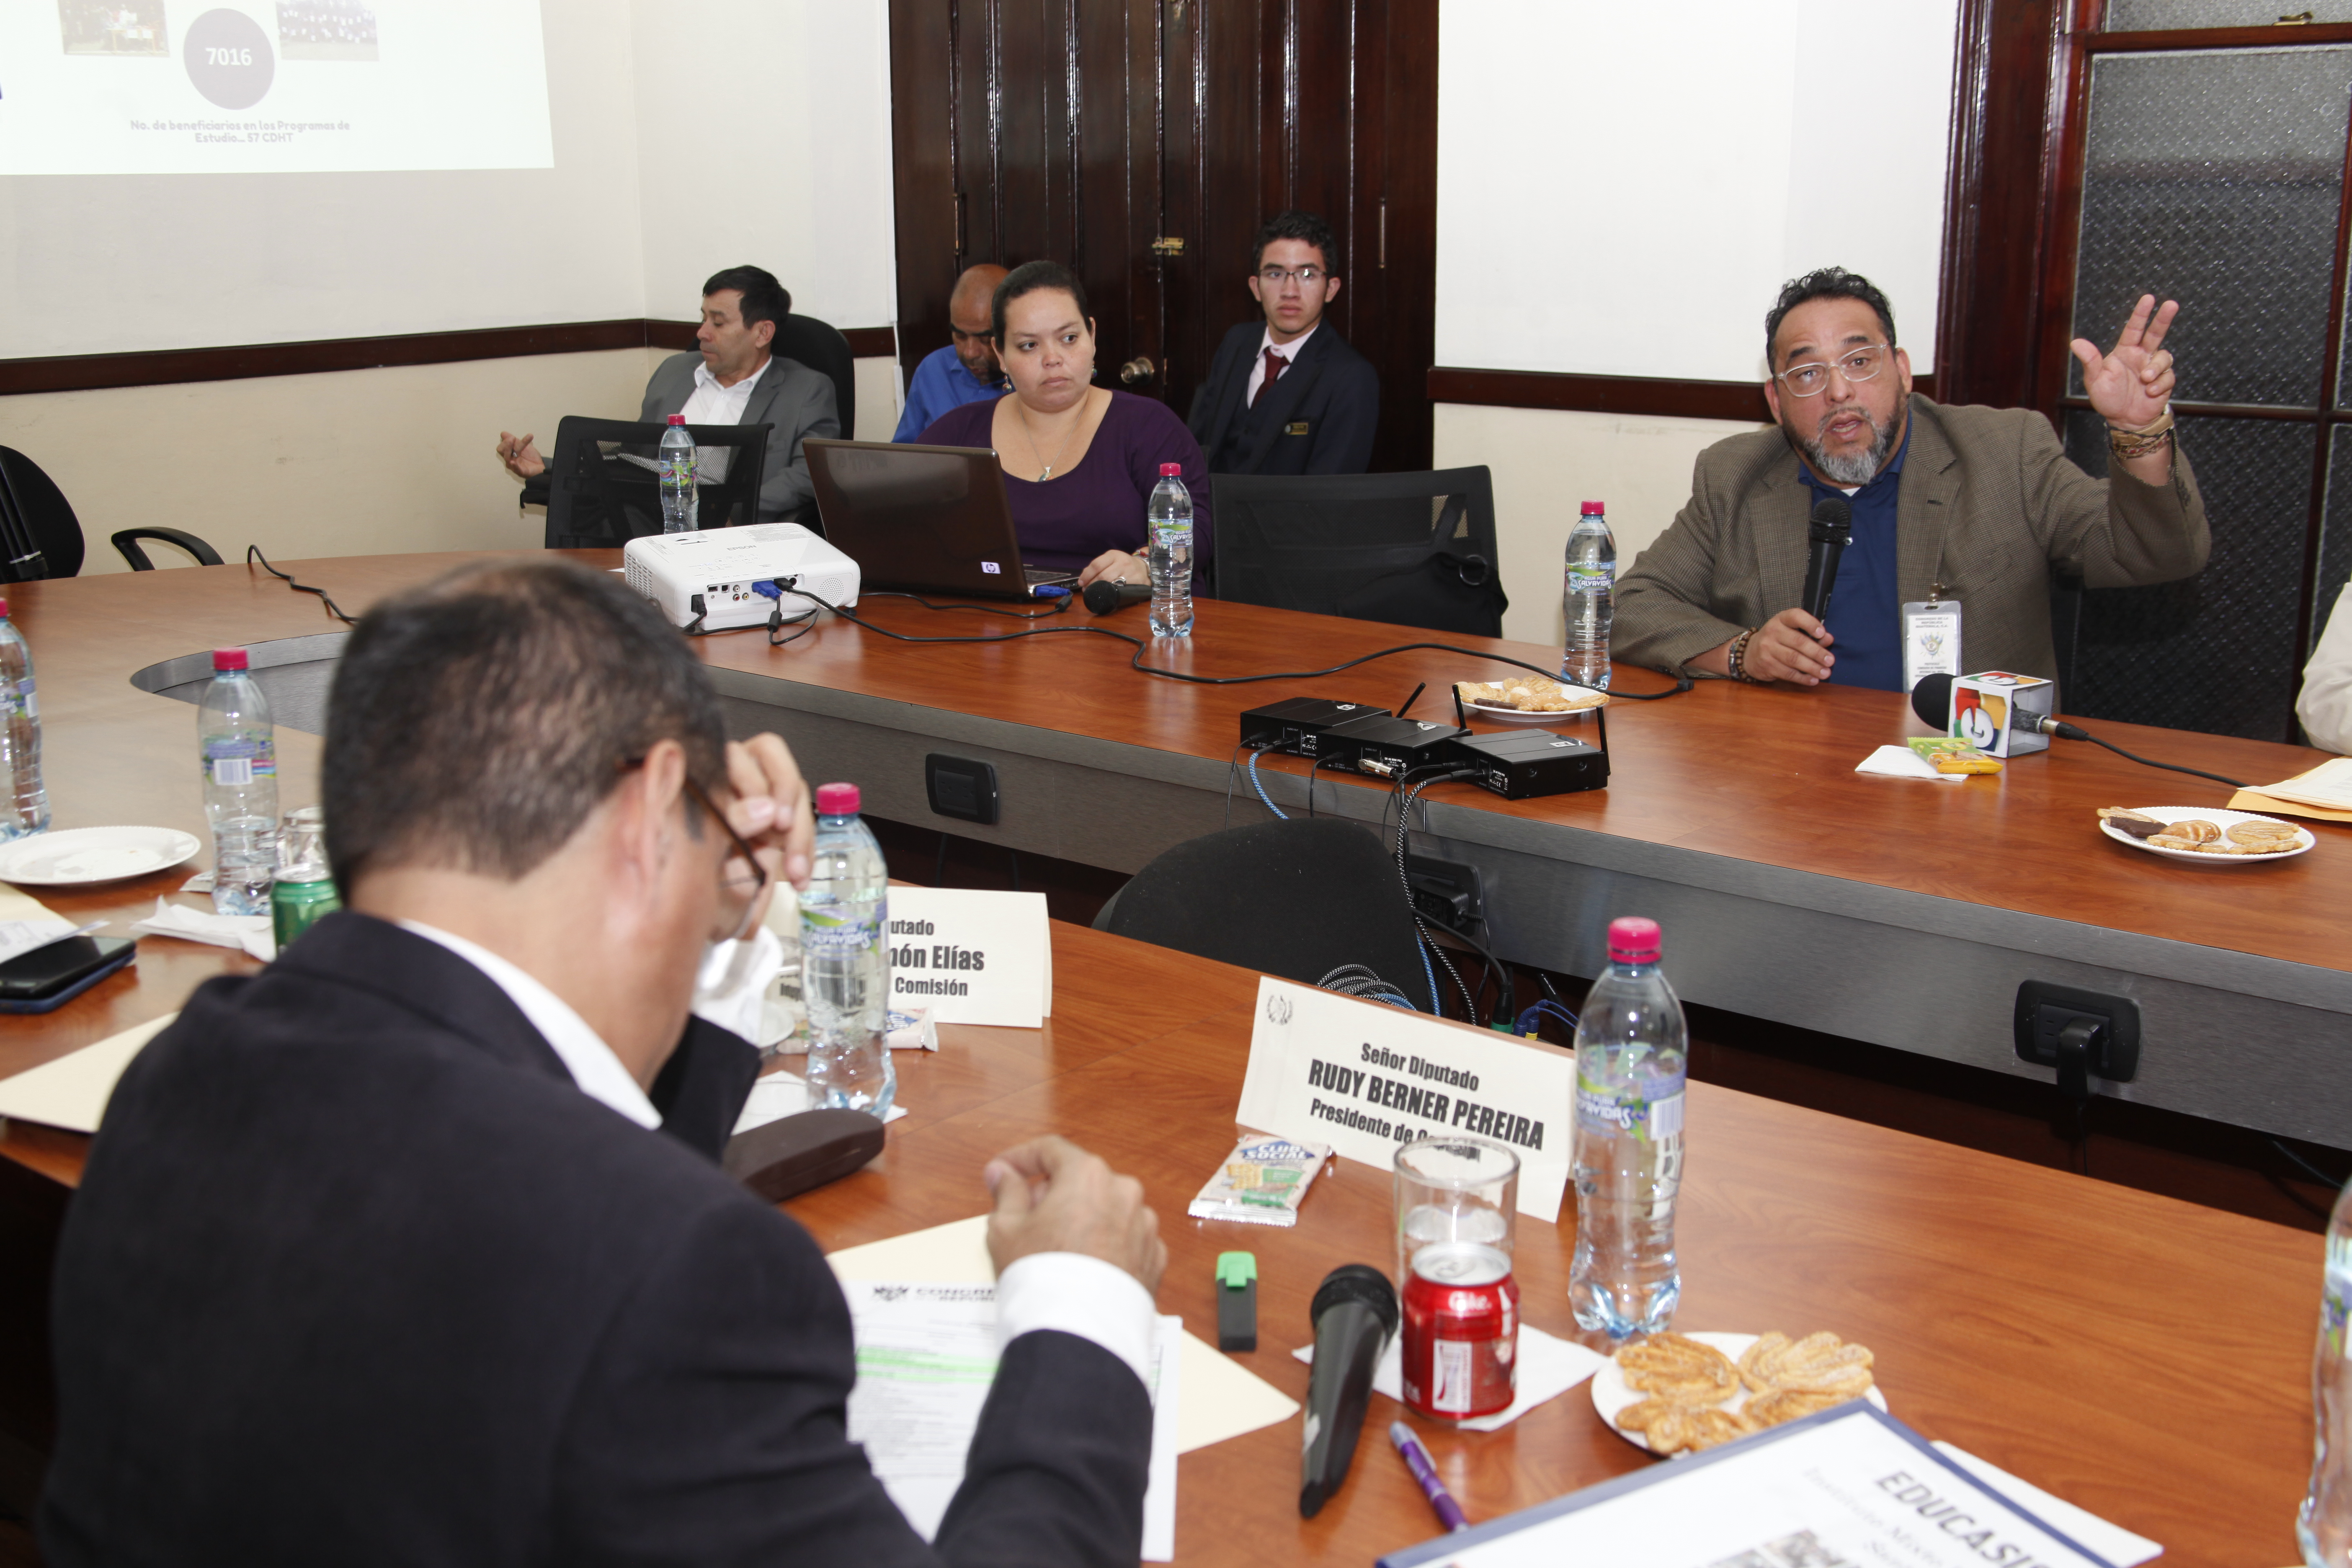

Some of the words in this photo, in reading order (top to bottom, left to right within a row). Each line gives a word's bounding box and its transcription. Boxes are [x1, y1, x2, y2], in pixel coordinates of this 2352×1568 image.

[205, 47, 252, 66] 7016
[130, 120, 150, 130] No.
[152, 120, 166, 130] de
[169, 120, 241, 130] beneficiarios
[259, 120, 275, 130] los
[277, 120, 335, 132] Programas
[337, 120, 350, 130] de
[262, 132, 293, 142] CDHT
[1577, 580, 1612, 589] SALVAVIDAS
[890, 919, 934, 936] utado
[805, 929, 872, 949] SALVAVIDAS
[932, 945, 985, 970] Elías
[895, 977, 968, 996] Comisión
[1361, 1042, 1406, 1071] Señor
[1408, 1055, 1479, 1091] Diputado
[1308, 1059, 1366, 1097] RUDY
[1367, 1075, 1450, 1123] BERNER
[1451, 1099, 1544, 1150] PEREIRA
[1310, 1098, 1391, 1138] Presidente
[1393, 1123, 1413, 1146] de
[1258, 1143, 1302, 1152] CLUB
